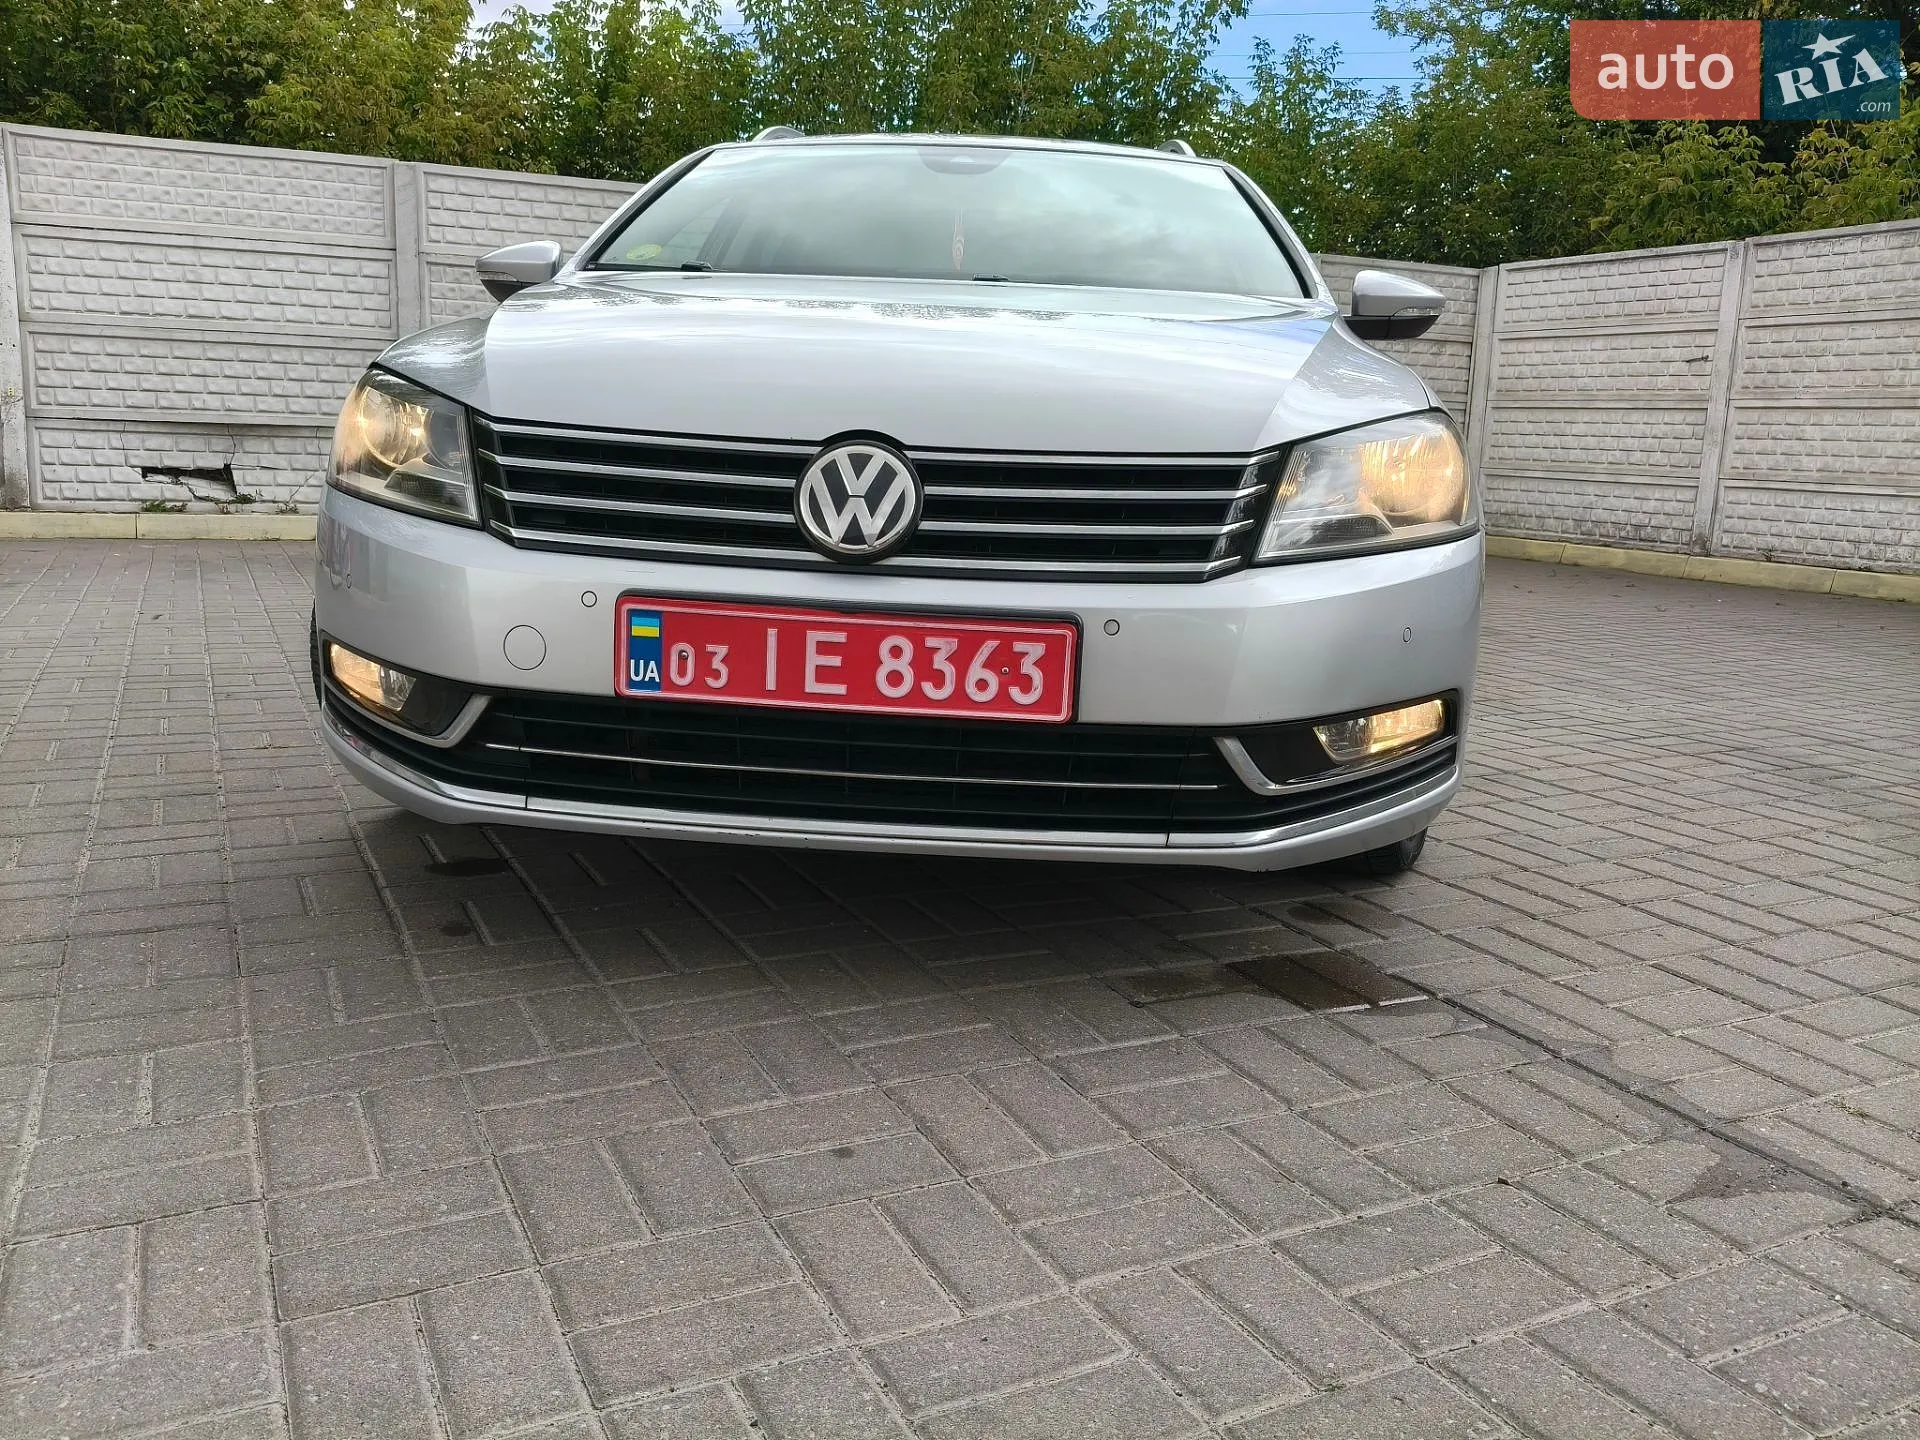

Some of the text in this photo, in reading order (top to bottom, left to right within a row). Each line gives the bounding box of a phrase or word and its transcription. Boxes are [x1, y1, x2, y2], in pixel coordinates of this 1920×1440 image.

[801, 446, 915, 554] VW
[630, 659, 660, 682] UA
[669, 642, 729, 689] 03
[875, 635, 1046, 706] 8363
